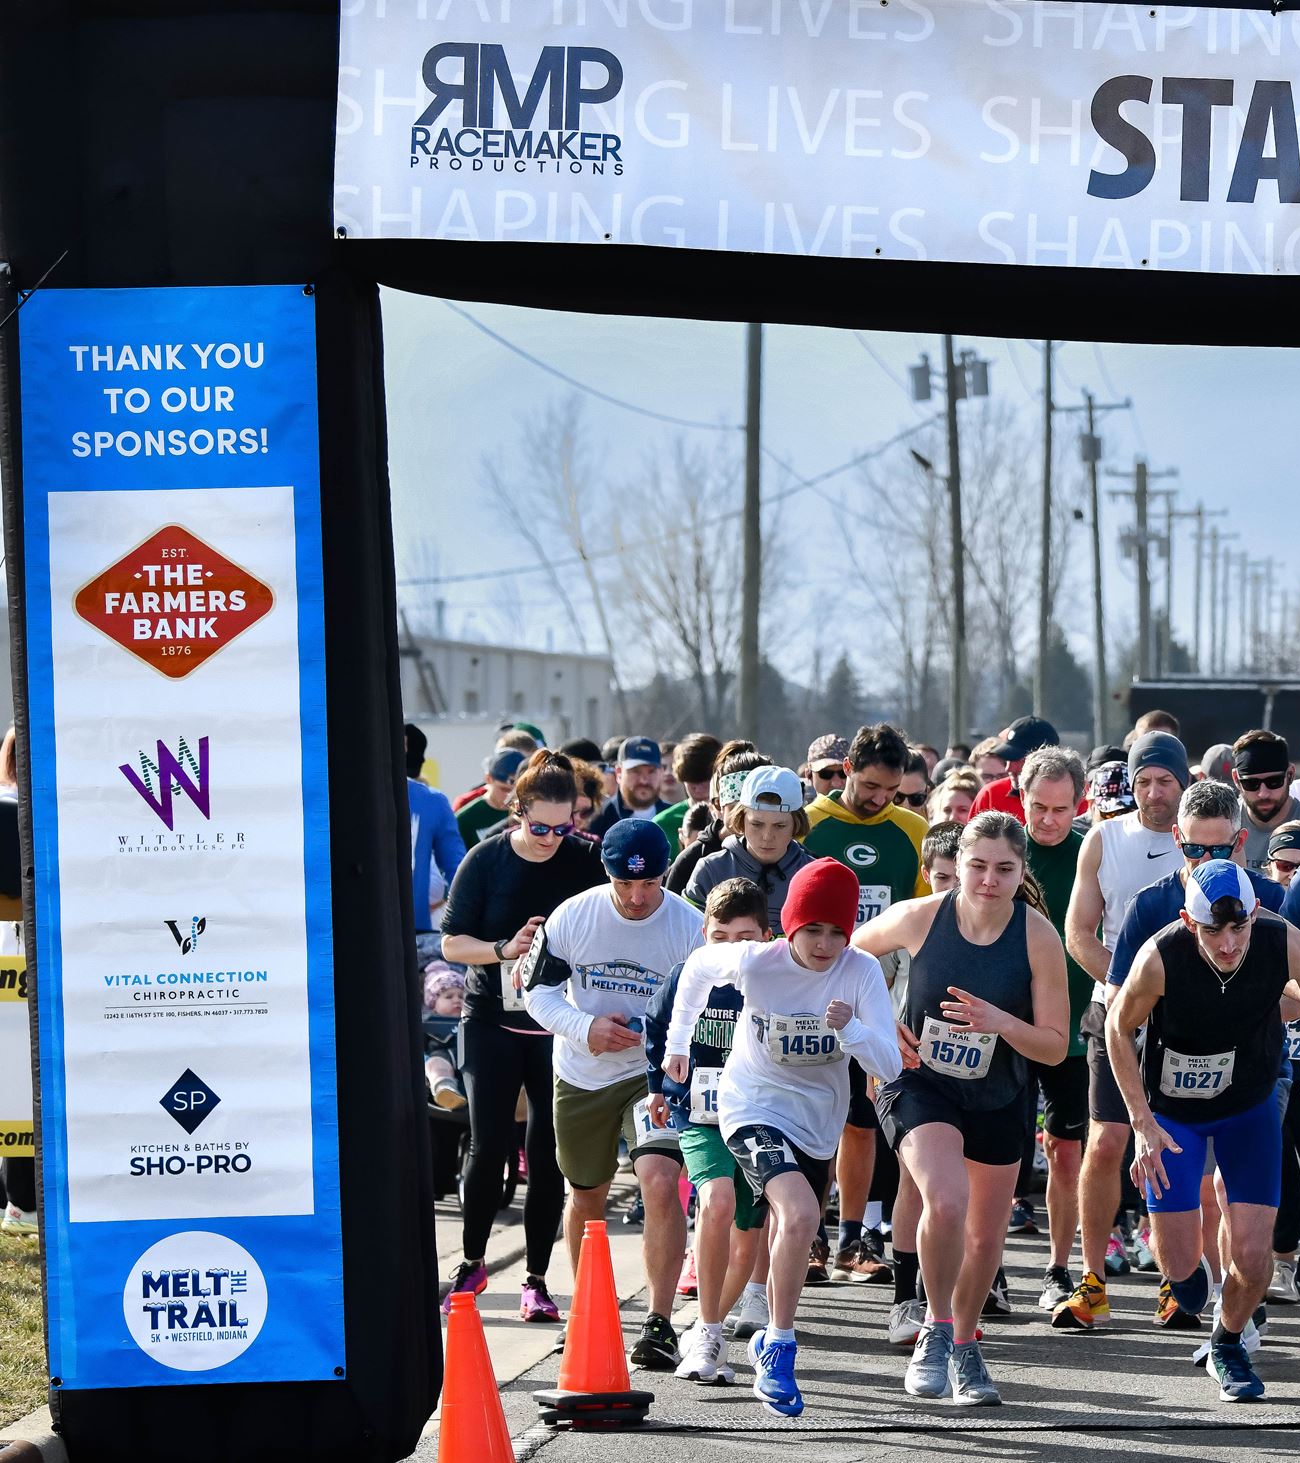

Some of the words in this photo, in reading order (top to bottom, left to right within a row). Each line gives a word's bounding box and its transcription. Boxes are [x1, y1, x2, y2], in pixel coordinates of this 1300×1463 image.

[721, 82, 932, 160] LIVES
[410, 126, 623, 162] RACEMAKER
[410, 156, 624, 176] PRODUCTIONS
[69, 344, 187, 371] THANK
[191, 342, 265, 370] YOU
[103, 387, 151, 414] TO
[160, 386, 235, 413] OUR
[71, 428, 269, 457] SPONSORS!
[161, 547, 190, 559] EST.
[142, 564, 204, 586] THE
[104, 590, 247, 614] FARMERS
[133, 617, 218, 640] BANK
[160, 645, 192, 656] 1876
[118, 832, 245, 845] WITTLER
[856, 904, 881, 922] 677
[104, 973, 153, 987] VITAL
[156, 970, 268, 985] CONNECTION
[133, 989, 241, 1001] CHIROPRACTIC
[704, 1007, 735, 1020] NOTRE
[779, 1035, 836, 1055] 1450
[948, 1033, 970, 1041] TRAIL
[931, 1040, 982, 1069] 1570
[1172, 1070, 1223, 1089] 1627
[173, 1091, 207, 1111] SP
[130, 1143, 180, 1154] KITCHEN
[183, 1143, 191, 1152] &
[195, 1142, 231, 1152] BATHS
[235, 1141, 250, 1151] BY
[129, 1153, 252, 1177] SHO-PRO
[142, 1268, 230, 1299] MELT
[231, 1269, 247, 1295] THE
[143, 1298, 249, 1330] TRAIL
[150, 1333, 161, 1343] 5K
[171, 1331, 215, 1342] WESTFIELD,
[216, 1330, 248, 1340] INDIANA
